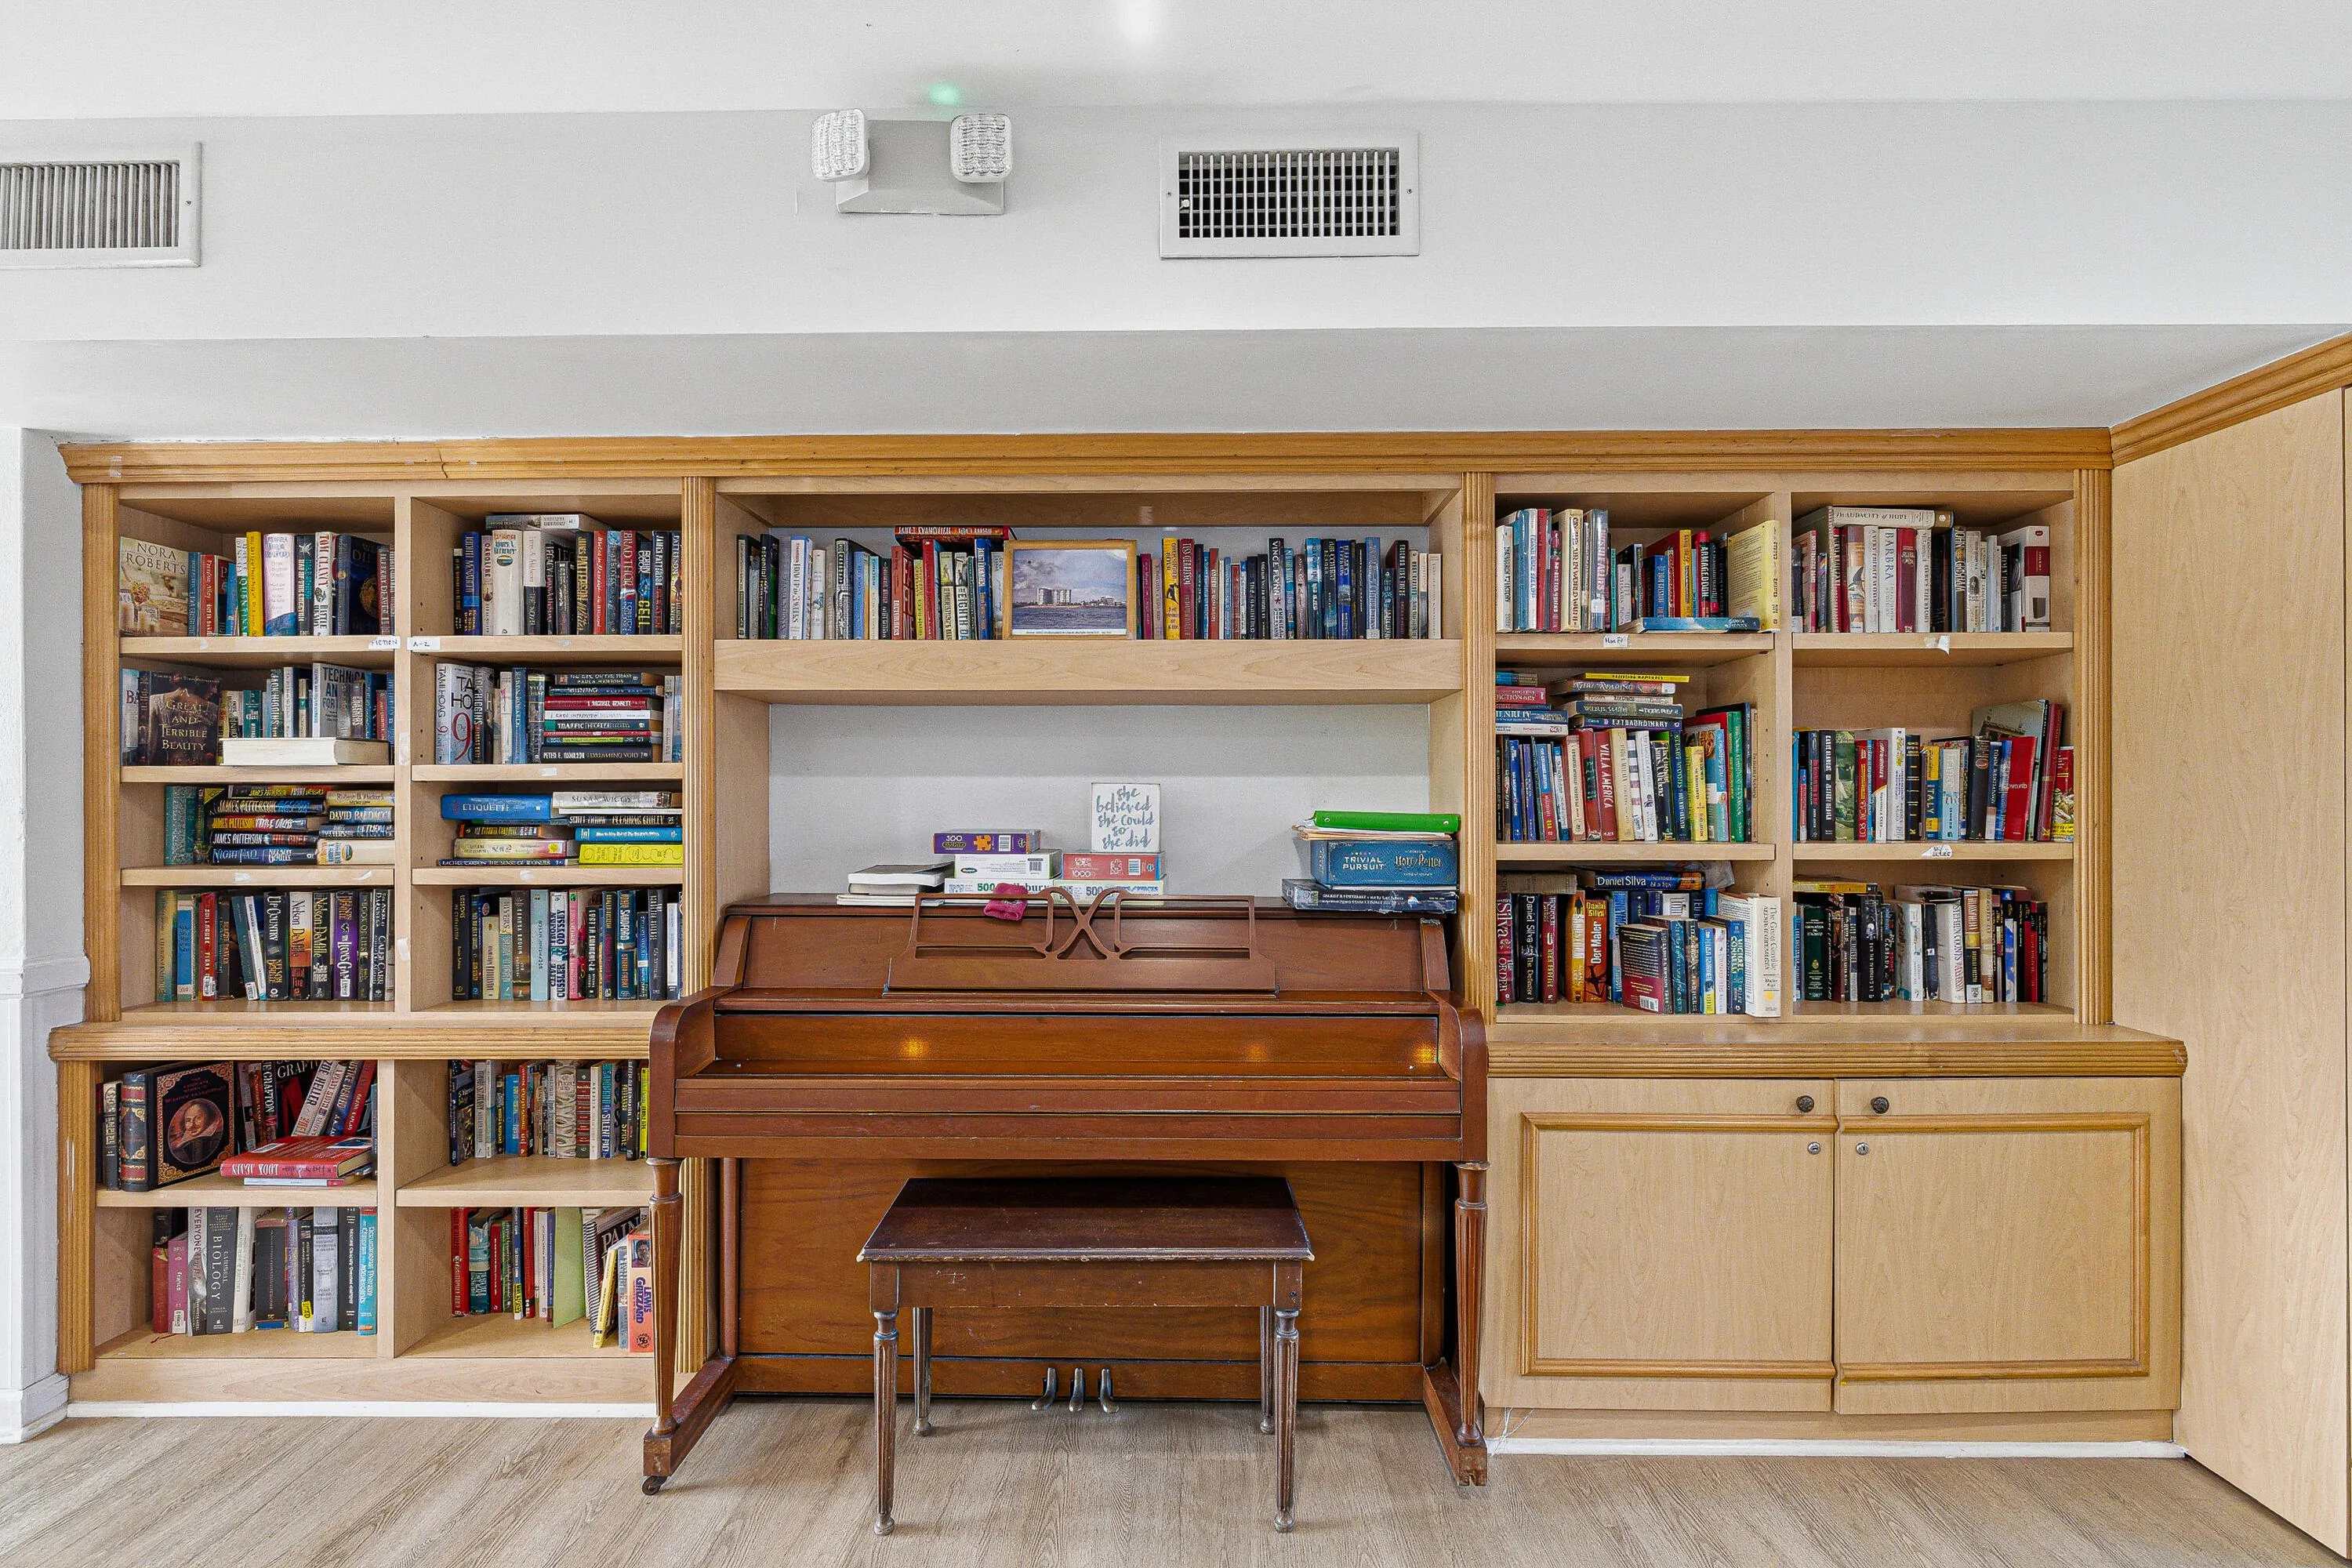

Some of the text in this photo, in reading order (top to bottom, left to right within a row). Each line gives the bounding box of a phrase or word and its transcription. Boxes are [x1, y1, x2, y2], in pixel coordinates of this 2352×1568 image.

[125, 552, 187, 575] ROBERTS
[137, 542, 176, 561] NORA
[623, 533, 633, 586] BRAD THOR
[1955, 530, 1965, 591] JOHN GRISHAM
[578, 557, 587, 600] PATTERSON
[1700, 546, 1709, 597] ARMAGEDDON
[638, 601, 650, 628] CELL
[958, 593, 969, 626] EIGHTH
[166, 699, 202, 712] GREAT
[181, 688, 189, 697] A
[172, 715, 195, 724] AND
[474, 693, 483, 725] HIGGINS
[159, 724, 207, 738] TERRIBLE
[162, 739, 206, 751] BEAUTY
[1600, 744, 1613, 808] VILLA AMERICA
[1096, 797, 1152, 814] believed
[1116, 786, 1139, 799] she
[219, 800, 276, 812] JAMES PATTERSON
[1098, 812, 1154, 827] she could
[1112, 826, 1126, 837] so
[213, 833, 263, 844] JAMES PATTERSON
[1102, 830, 1152, 848] she did
[977, 883, 996, 891] 500
[1596, 876, 1646, 886] Daniel Silva
[1497, 902, 1512, 938] Silva
[1526, 896, 1534, 922] Daniel
[267, 908, 280, 941] COUNTRY
[292, 900, 306, 956] Nelson DeMille
[314, 898, 327, 957] Nelson DeMille
[620, 909, 630, 940] SANDFORD
[1526, 925, 1534, 942] Silva
[338, 962, 352, 980] GAM
[1499, 957, 1508, 991] ORDER
[263, 1073, 274, 1112] GRAFTON
[306, 1077, 326, 1106] HELLER
[602, 1114, 611, 1137] SILENT
[211, 1236, 222, 1299] BIOLOGY
[635, 1277, 646, 1323] GRIZZARD
[644, 1286, 652, 1312] LEWIS
